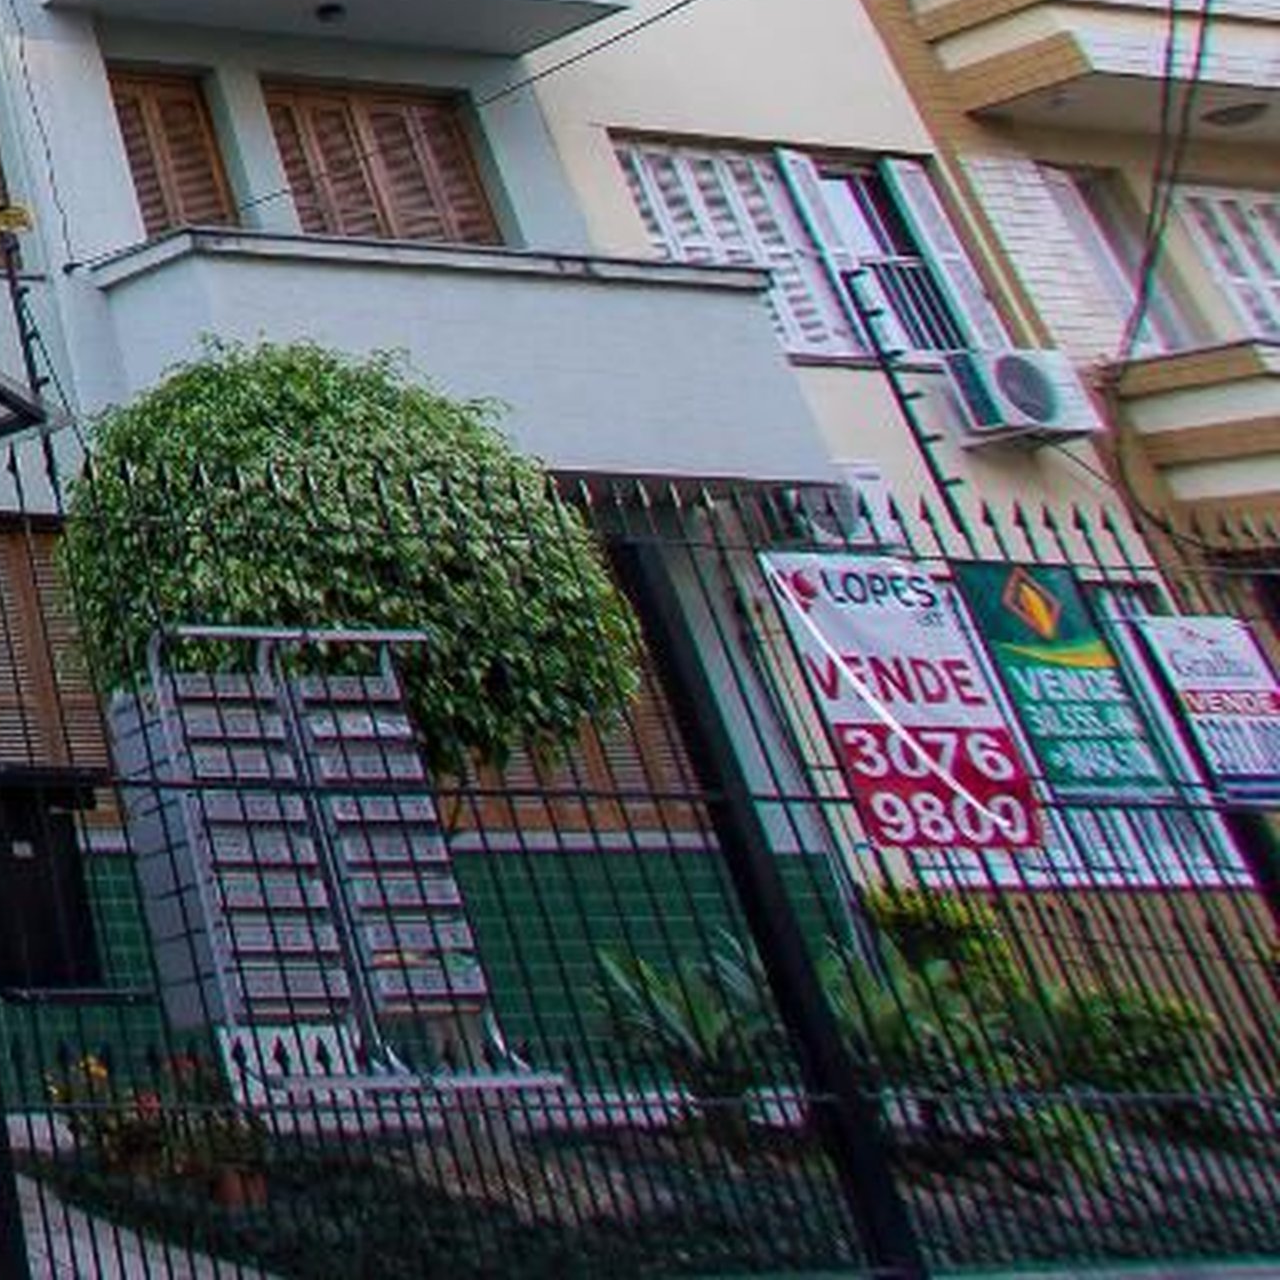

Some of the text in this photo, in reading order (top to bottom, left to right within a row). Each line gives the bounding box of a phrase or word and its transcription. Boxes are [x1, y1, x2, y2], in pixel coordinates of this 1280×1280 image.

[820, 569, 938, 608] LOPES
[805, 655, 987, 705] VENDE
[843, 728, 1014, 781] 3076
